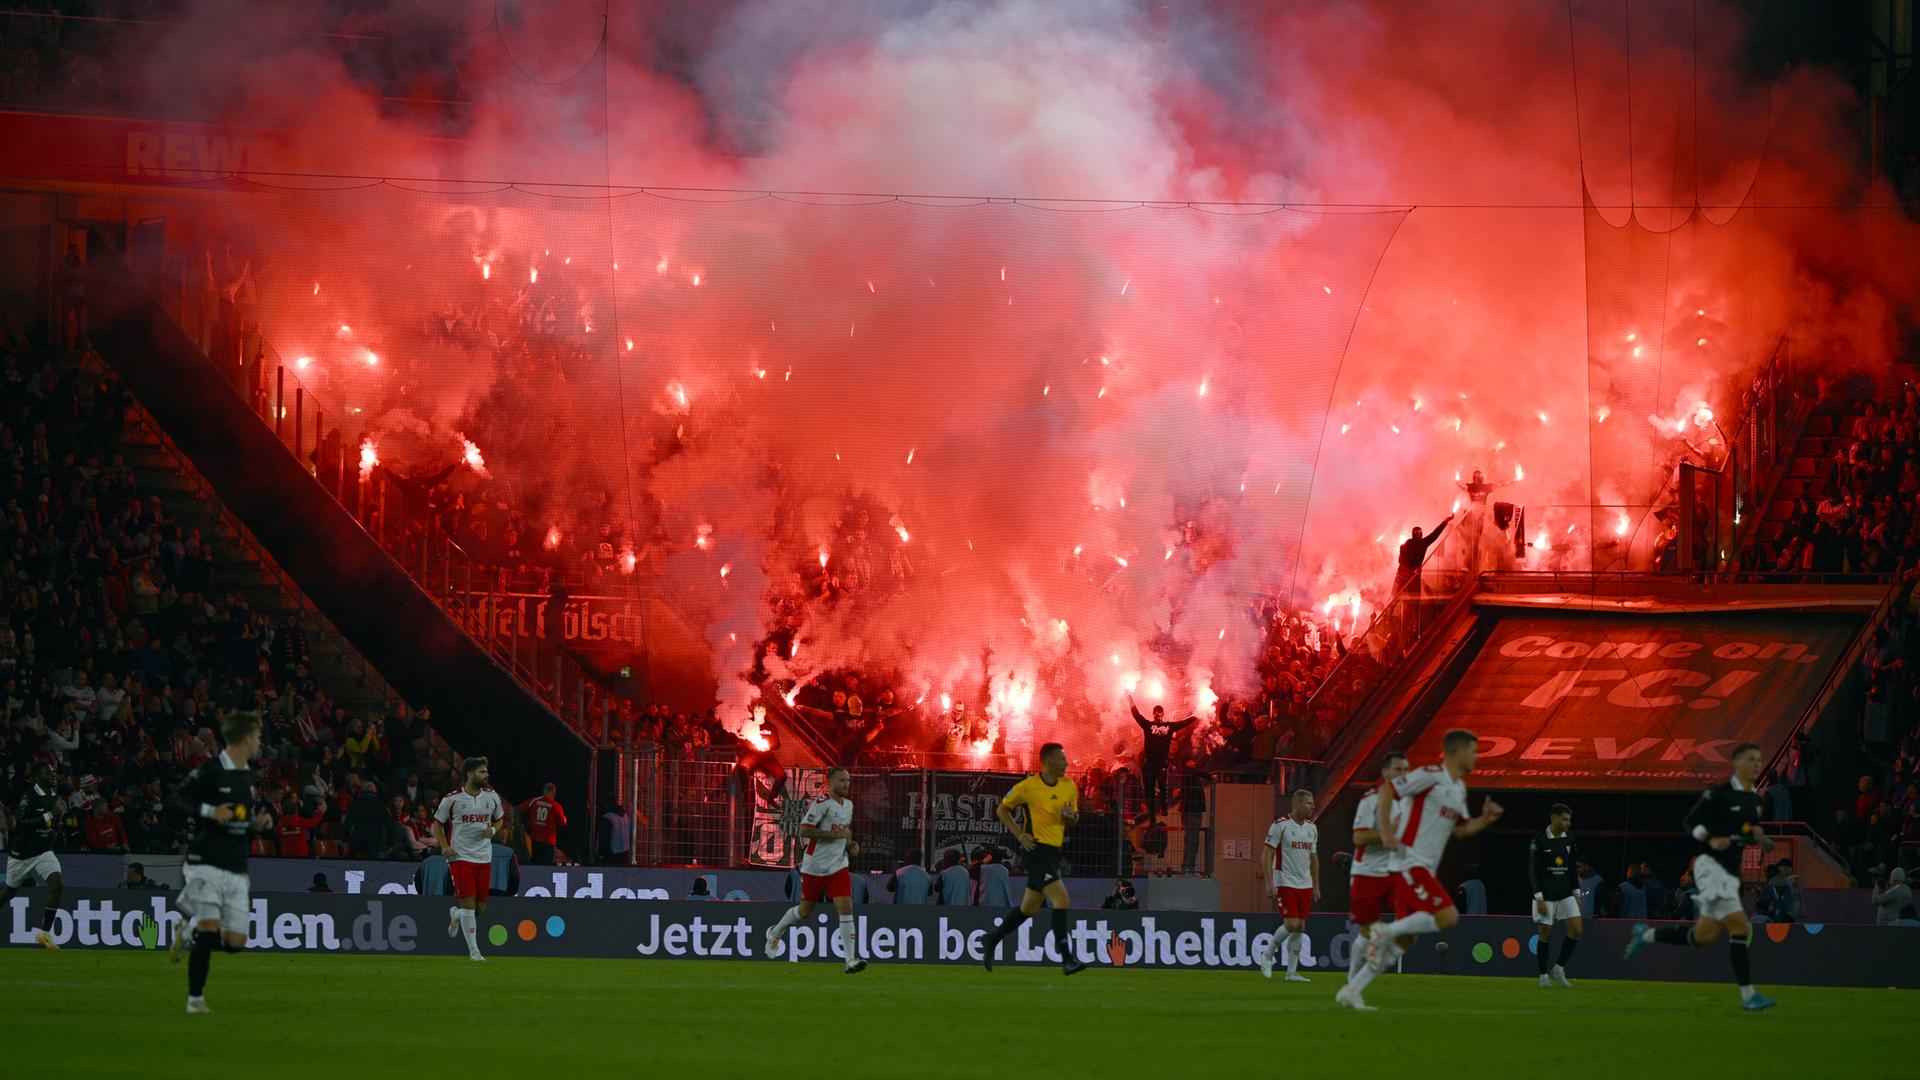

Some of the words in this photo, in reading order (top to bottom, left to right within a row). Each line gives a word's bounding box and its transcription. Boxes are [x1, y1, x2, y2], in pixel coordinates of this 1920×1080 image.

[1500, 635, 1703, 659] Come
[1712, 642, 1820, 664] on.
[1520, 669, 1761, 710] FC!
[1521, 769, 1593, 778] Getan.
[462, 814, 490, 824] REWE
[536, 806, 548, 819] 10
[1291, 841, 1312, 850] REWE
[636, 914, 752, 957] Jetzt
